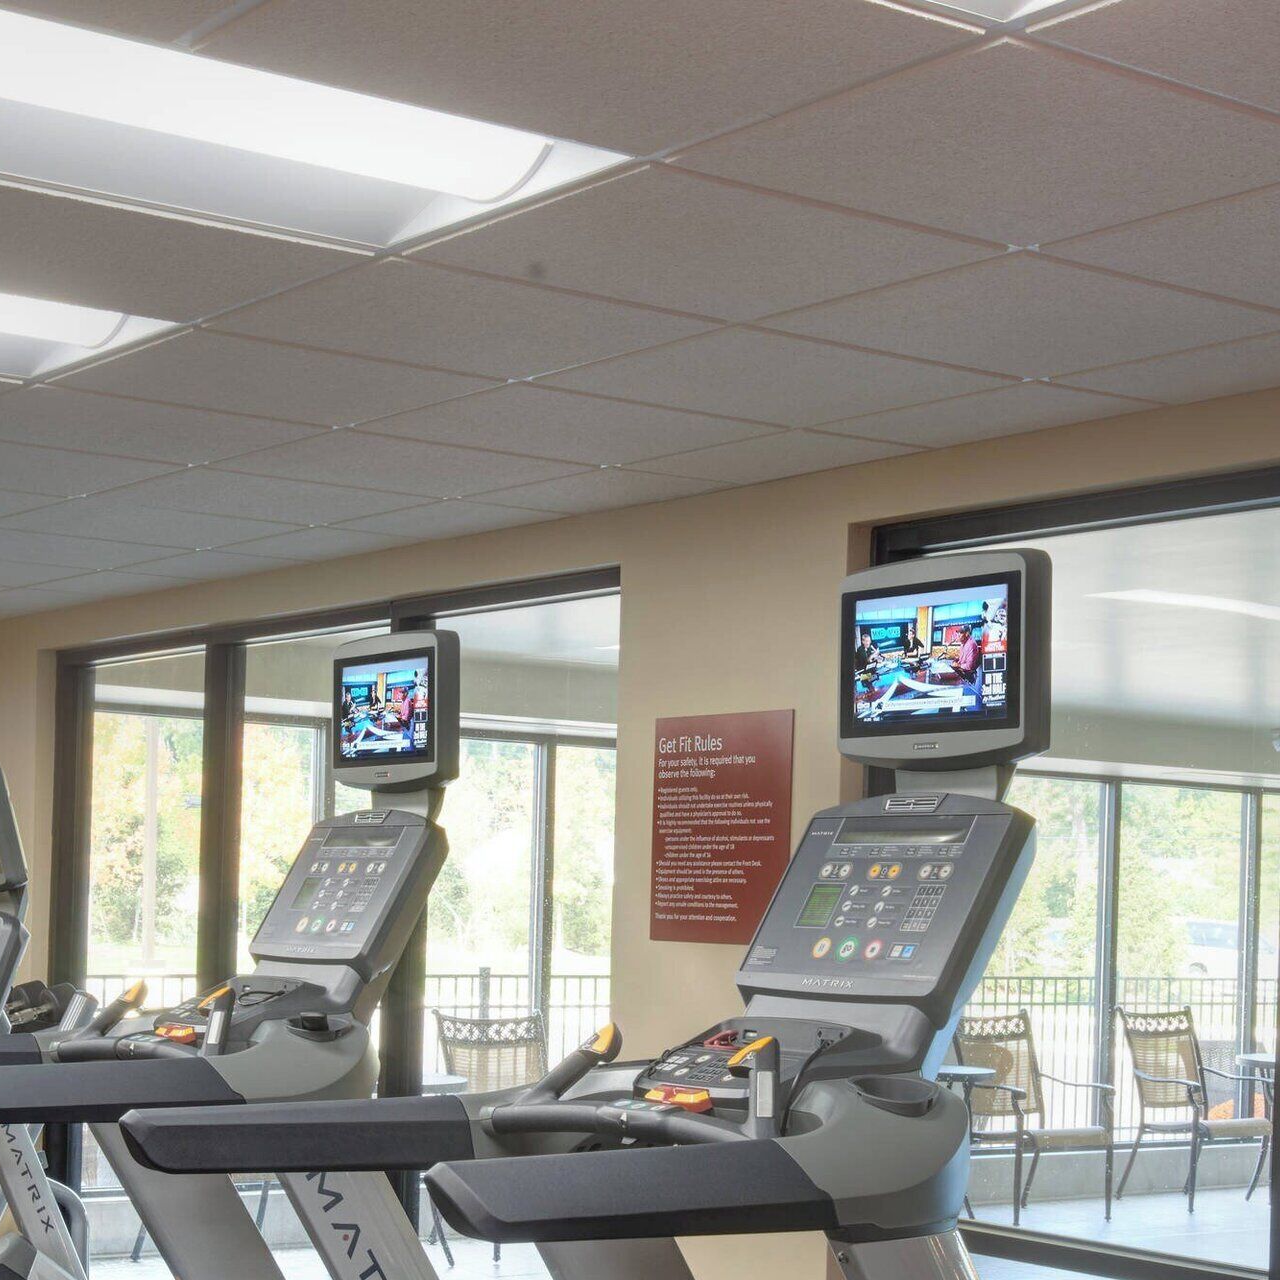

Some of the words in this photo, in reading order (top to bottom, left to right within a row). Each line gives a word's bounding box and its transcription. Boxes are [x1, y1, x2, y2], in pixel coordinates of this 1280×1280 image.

[659, 737, 677, 754] Get
[679, 736, 692, 752] Fit
[694, 734, 723, 752] Rules
[658, 759, 667, 767] For
[667, 759, 679, 768] your
[680, 757, 698, 768] safety,
[703, 757, 709, 765] is
[709, 755, 733, 767] required
[732, 754, 744, 764] that
[745, 755, 756, 765] you
[659, 770, 680, 778] observe
[680, 769, 689, 778] the
[690, 768, 716, 778] following:
[801, 979, 854, 988] MATRIX
[1, 1124, 54, 1234] MATRIX
